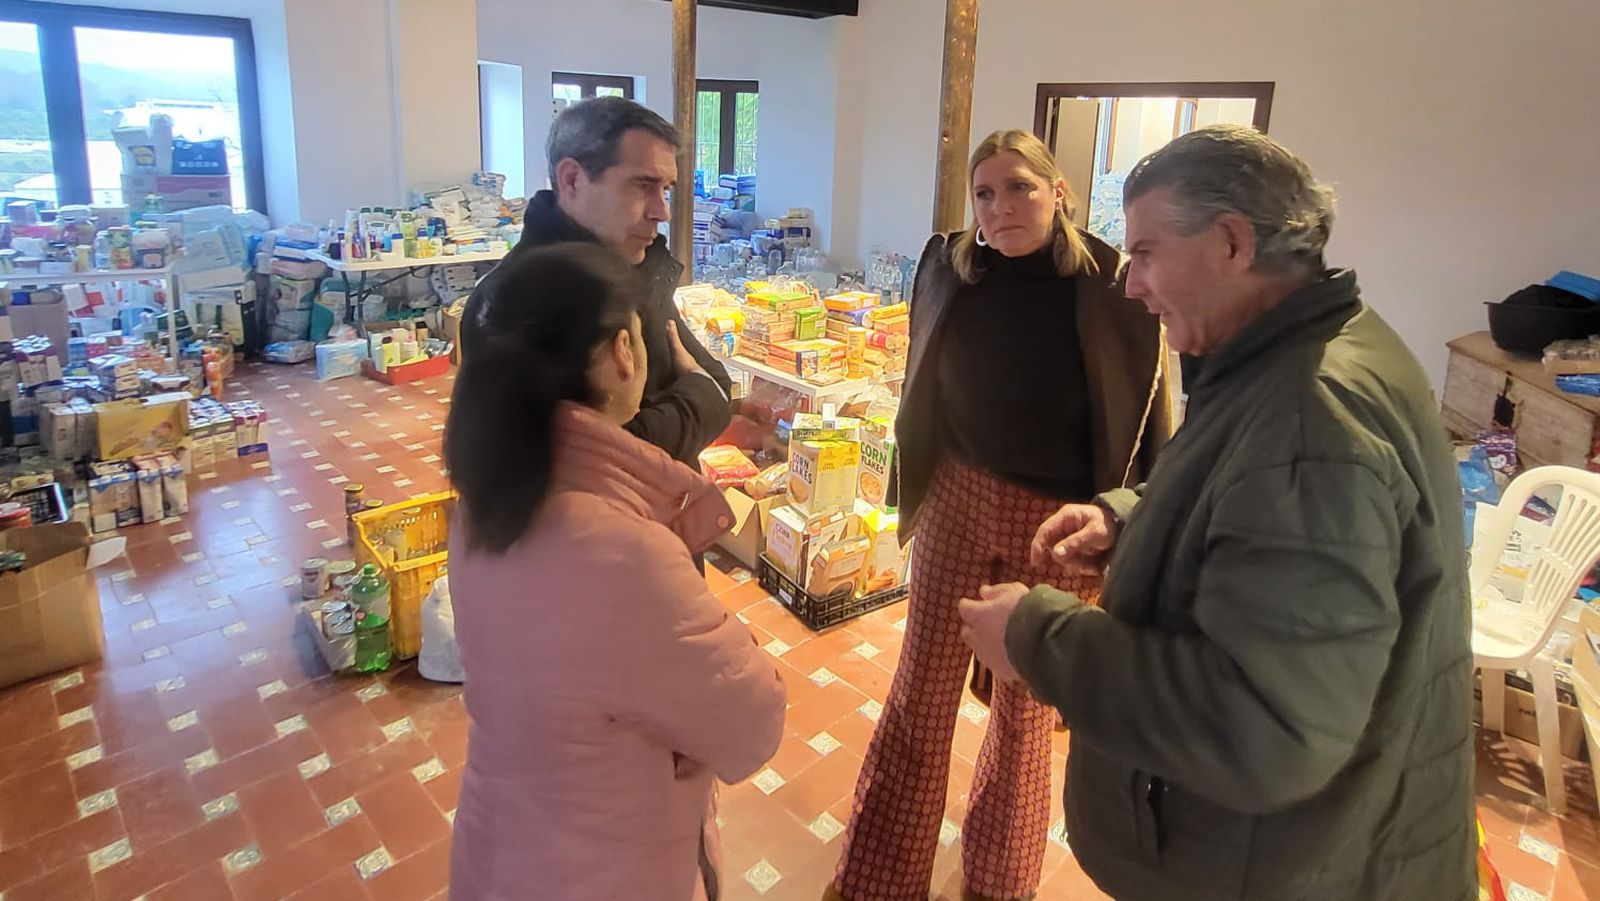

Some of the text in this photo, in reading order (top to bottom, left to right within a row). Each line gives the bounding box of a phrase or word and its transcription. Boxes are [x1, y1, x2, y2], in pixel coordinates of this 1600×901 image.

[792, 452, 810, 470] CORN
[860, 441, 887, 466] CORN
[790, 463, 812, 484] LAKES
[861, 455, 884, 475] FLAKES
